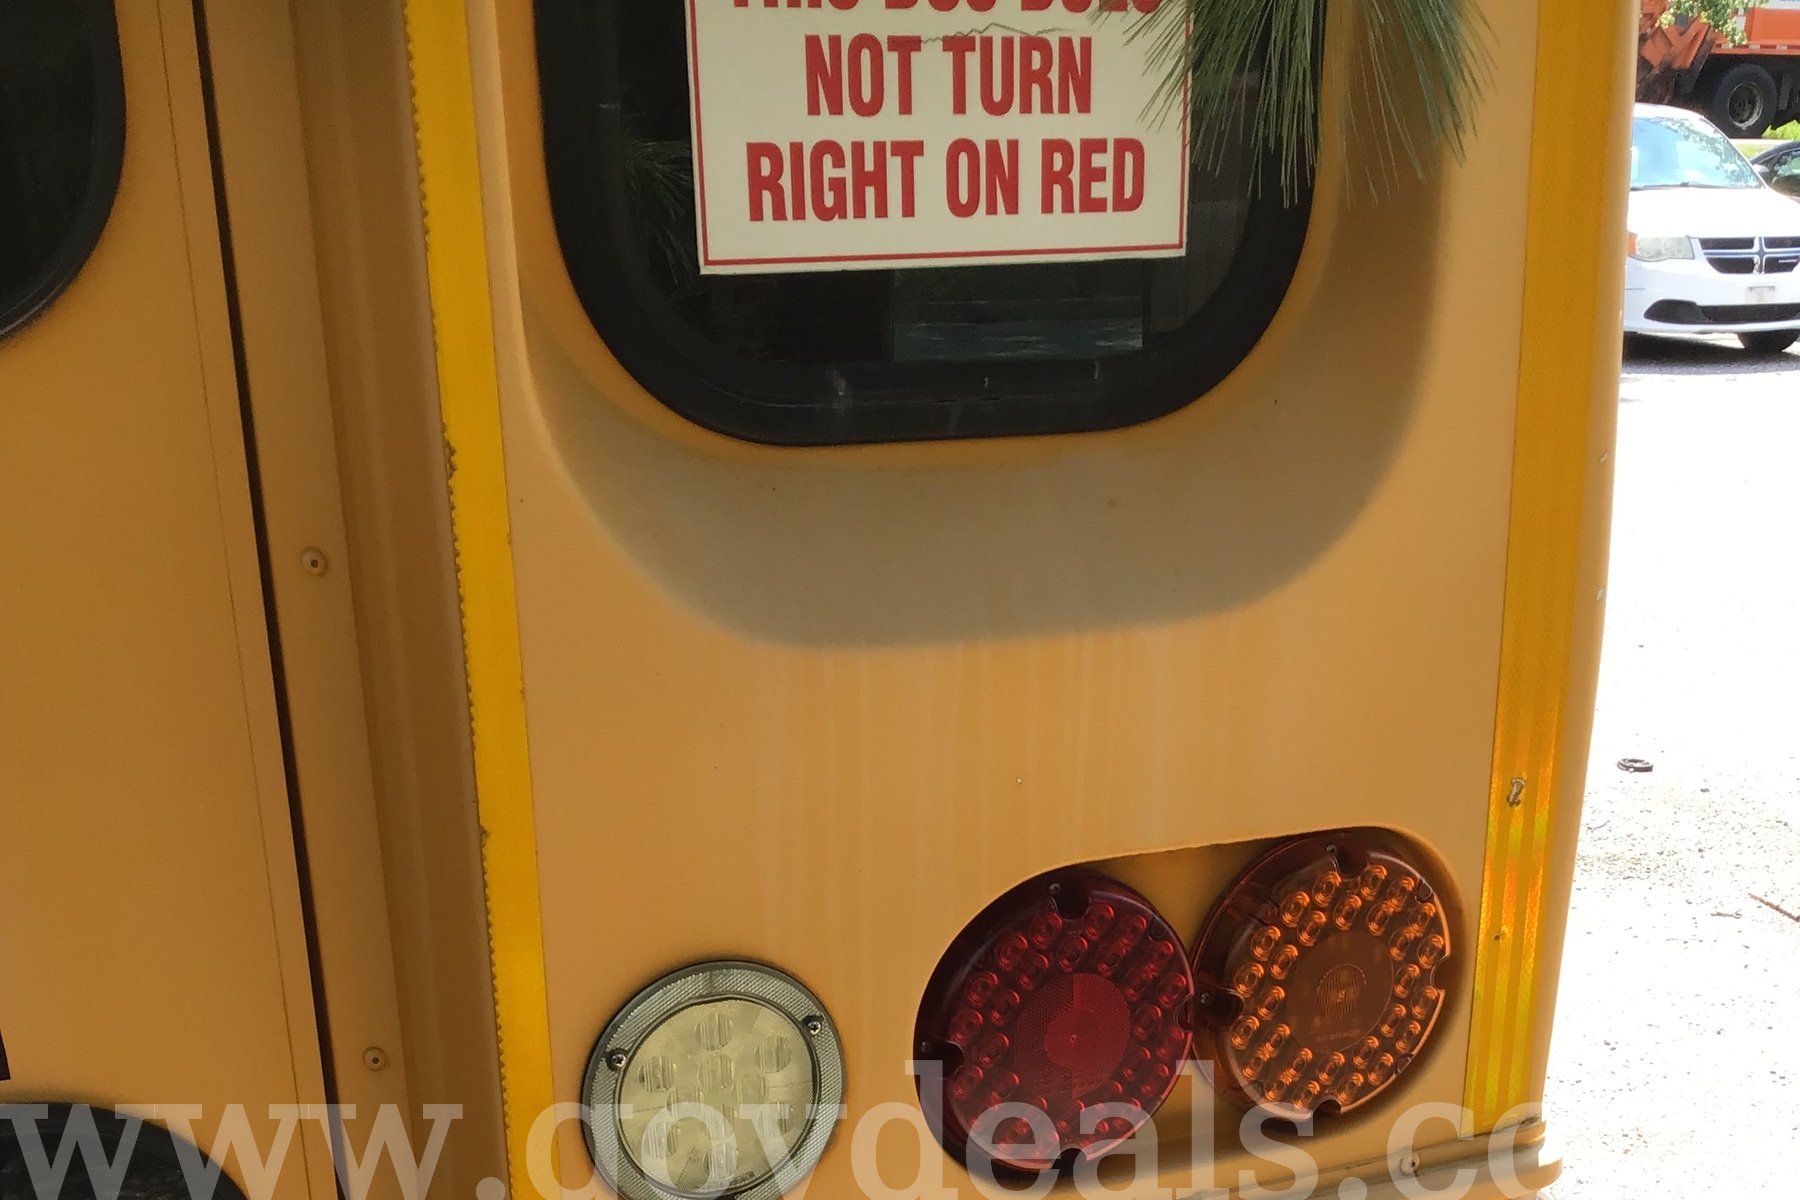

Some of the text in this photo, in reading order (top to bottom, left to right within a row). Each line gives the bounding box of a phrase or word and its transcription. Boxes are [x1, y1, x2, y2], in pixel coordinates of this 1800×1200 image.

[805, 33, 1092, 117] NOT TURN
[746, 137, 1146, 222] RIGHT ON RED
